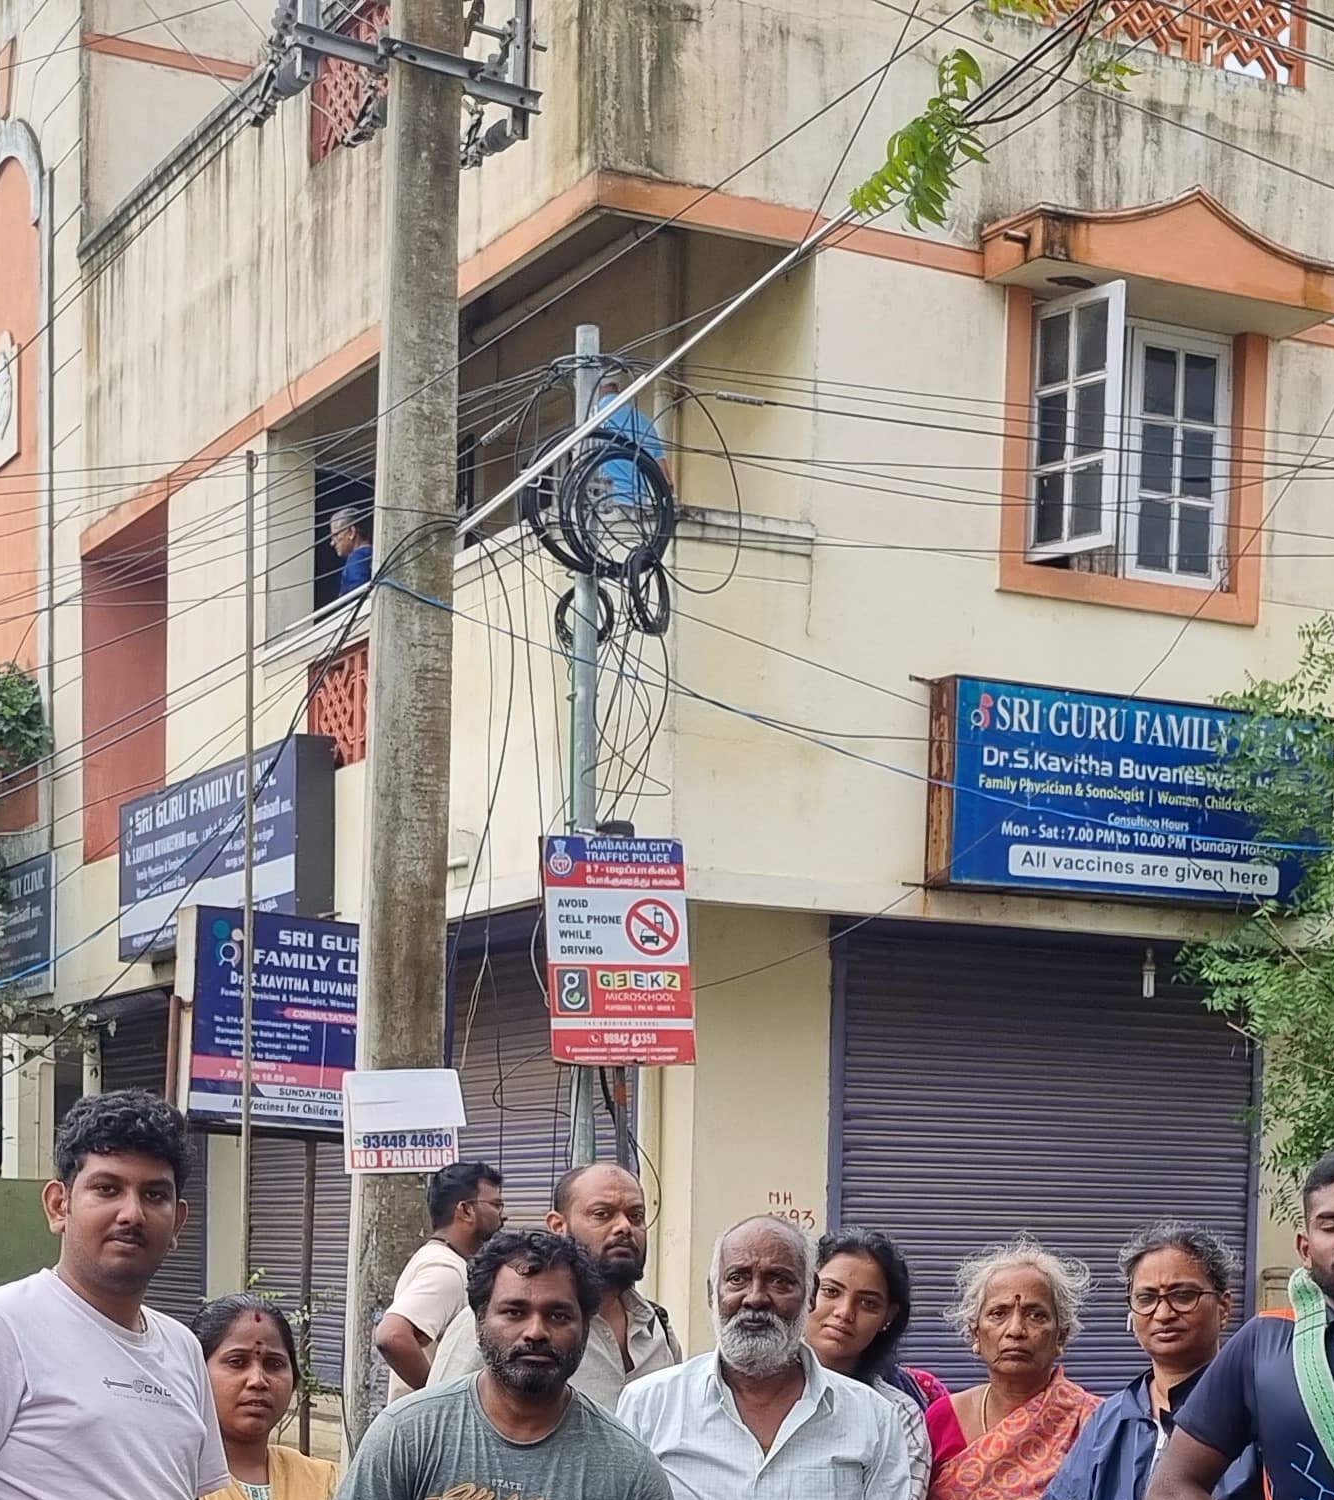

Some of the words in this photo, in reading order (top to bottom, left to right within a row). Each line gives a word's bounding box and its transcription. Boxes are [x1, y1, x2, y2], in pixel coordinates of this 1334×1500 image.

[996, 695, 1042, 734] SRI
[1048, 701, 1128, 742] GURU
[1133, 710, 1230, 752] FAMILY
[983, 746, 1114, 777] Dr.S.Kavitha
[979, 774, 1017, 794] Family
[1019, 777, 1073, 798] Physician
[1075, 783, 1084, 797] &
[1085, 784, 1144, 804] Sonologist
[134, 806, 154, 837] SRI
[155, 792, 188, 828] GURU
[189, 774, 234, 817] FAMILY
[1161, 818, 1189, 832] Hours
[1001, 821, 1029, 837] Mon
[1038, 824, 1058, 839] Sat
[1067, 826, 1094, 842] 7.00
[1096, 828, 1115, 844] PM
[1118, 832, 1130, 845] to
[1133, 832, 1166, 849] 10.00
[1168, 835, 1186, 850] PM
[1191, 838, 1238, 858] (Sunday
[585, 841, 647, 852] TAMBARAM
[649, 842, 674, 853] CITY
[585, 851, 629, 862] TRAFFIC
[632, 853, 670, 863] POLICE
[1021, 851, 1046, 868] All
[1053, 855, 1134, 875] vaccines
[1141, 864, 1169, 877] are
[1175, 862, 1223, 882] given
[1230, 867, 1268, 885] here
[558, 898, 589, 908] AVOID
[558, 914, 584, 924] CELL
[587, 915, 622, 925] PHONE
[278, 930, 314, 948] SRI
[321, 935, 360, 953] GUR
[559, 930, 592, 940] WHILE
[560, 945, 603, 955] DRIVING
[253, 949, 330, 972] FAMILY
[337, 958, 359, 975] CL
[312, 980, 358, 997] BUVANE
[605, 992, 675, 1002] MICROSCHOOL
[279, 1088, 317, 1099] SUNDAY
[319, 1090, 343, 1101] HOLI
[287, 1103, 299, 1113] for
[303, 1103, 338, 1117] Children
[363, 1134, 407, 1148] 93448
[410, 1134, 452, 1148] 44930
[353, 1151, 378, 1168] NO
[381, 1150, 454, 1168] PARKING
[144, 1384, 171, 1397] CNL
[491, 1479, 523, 1491] STATE
